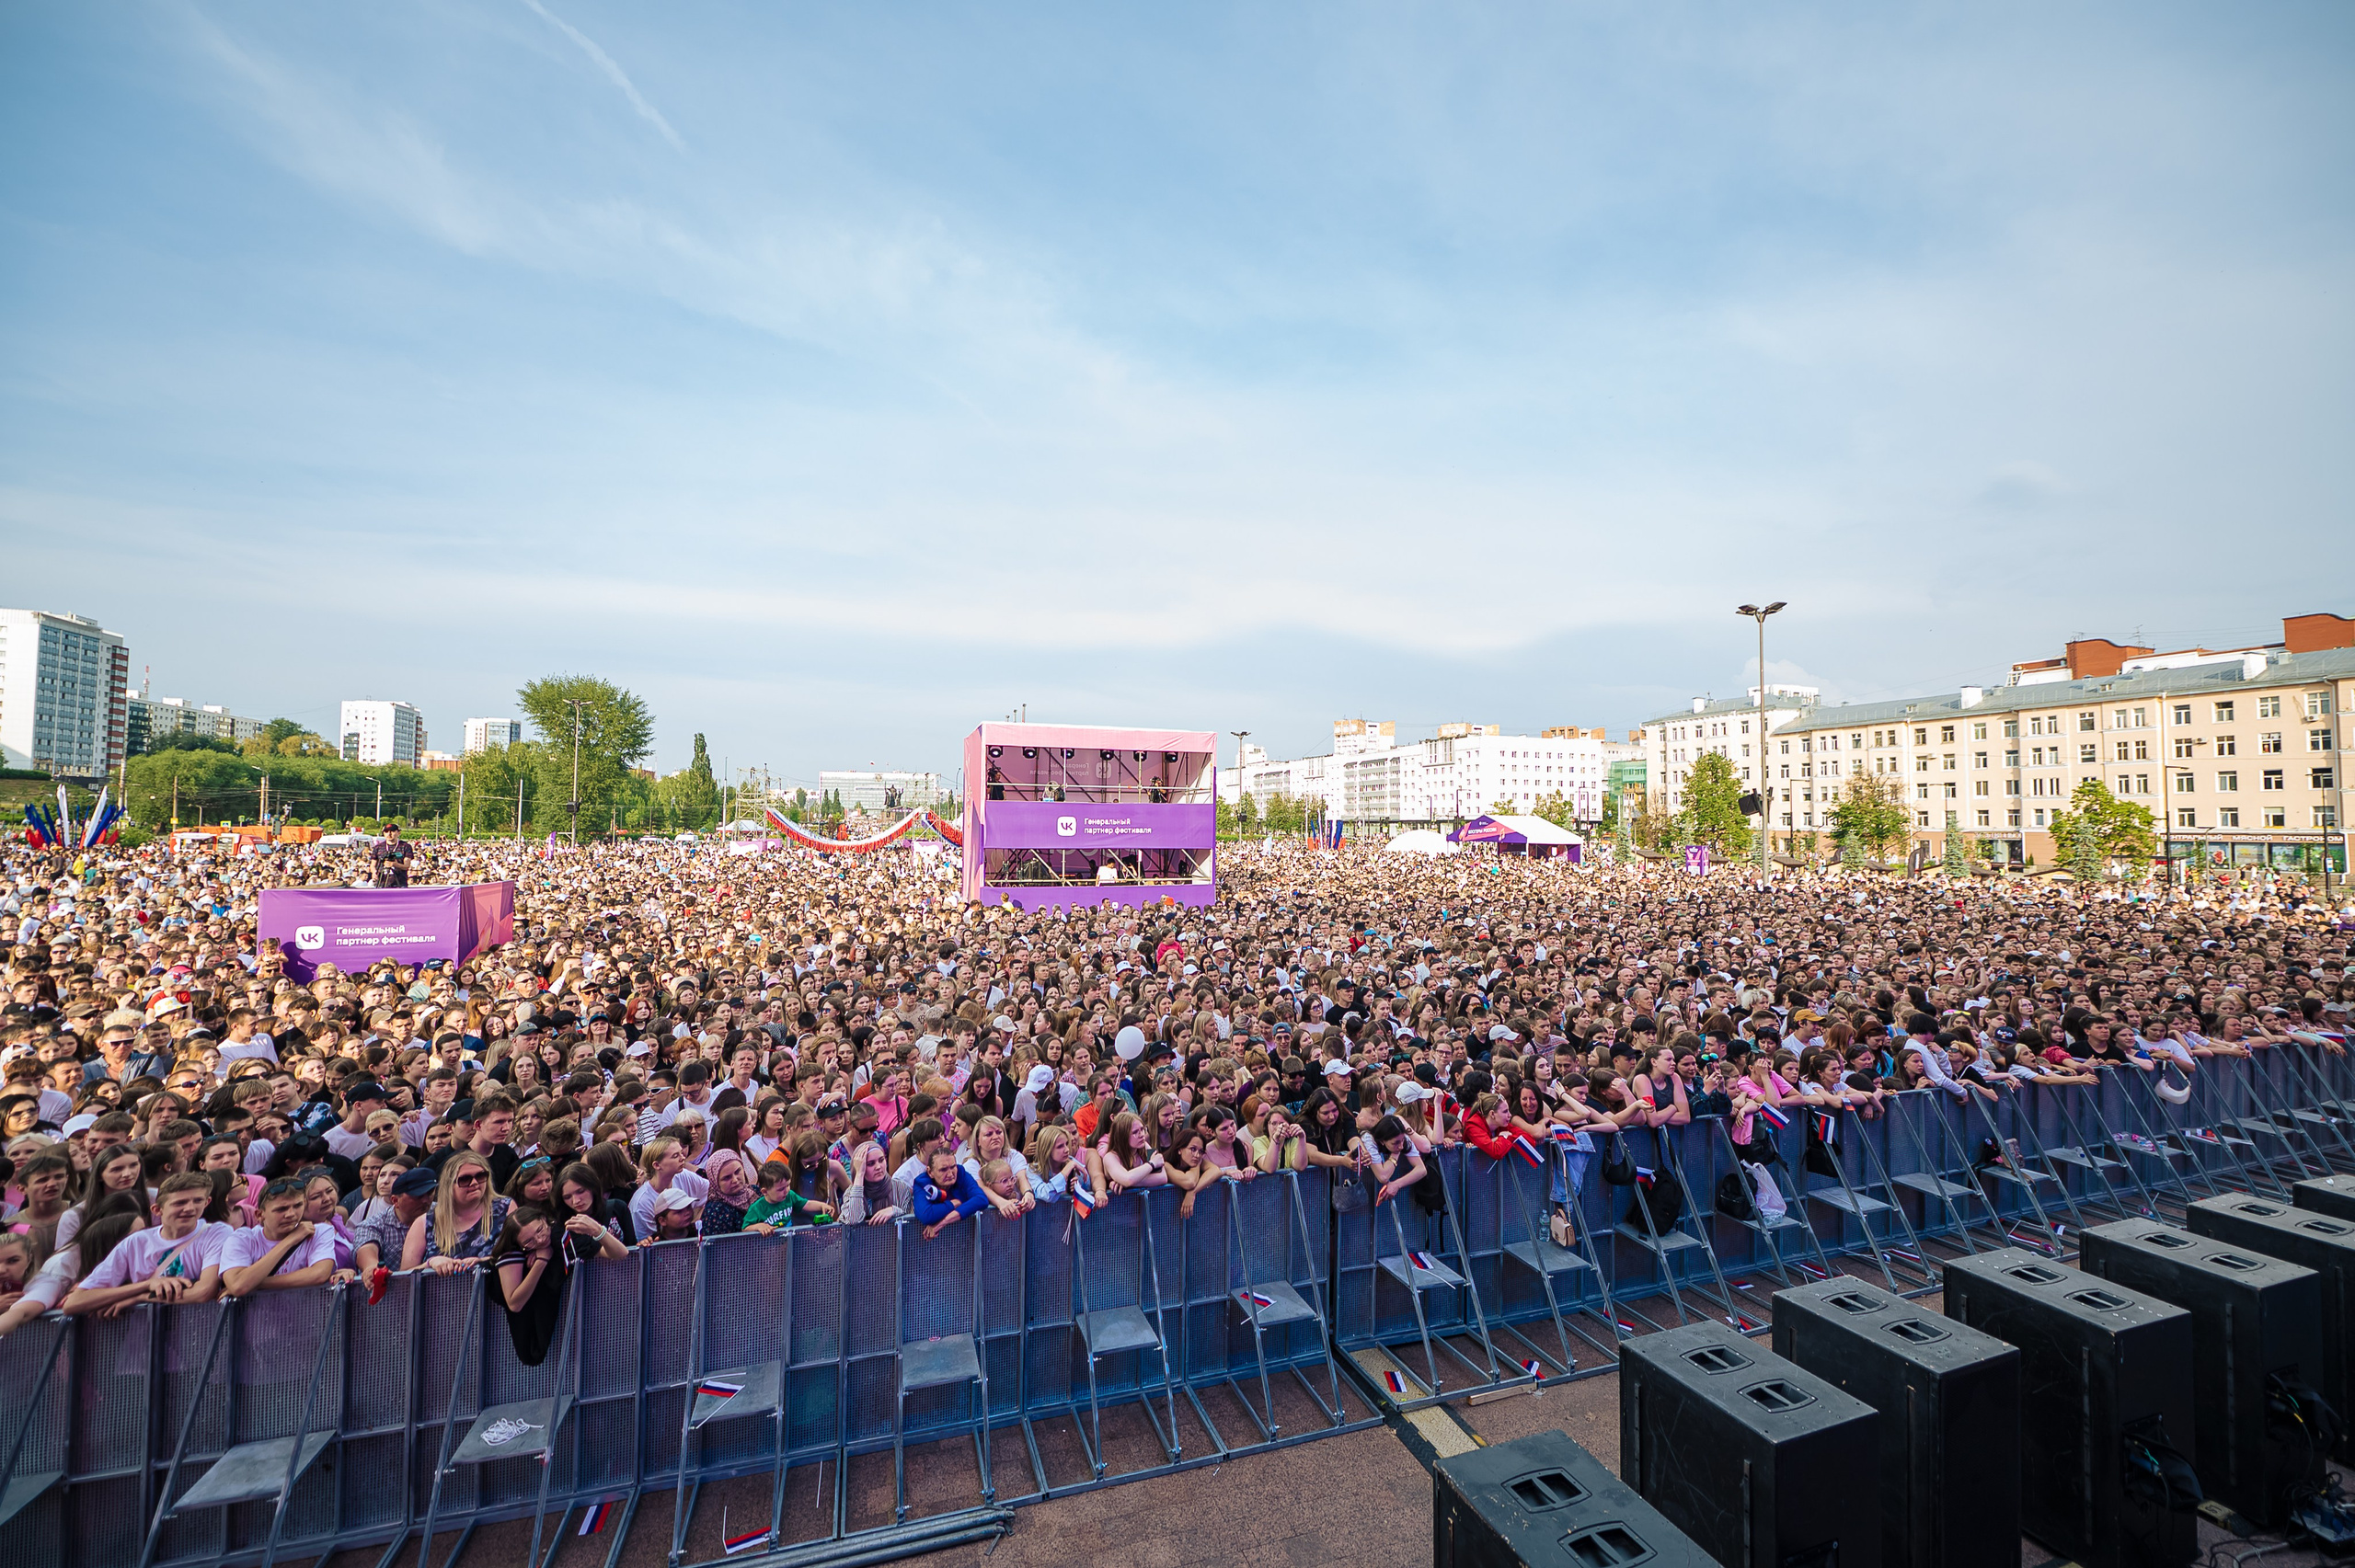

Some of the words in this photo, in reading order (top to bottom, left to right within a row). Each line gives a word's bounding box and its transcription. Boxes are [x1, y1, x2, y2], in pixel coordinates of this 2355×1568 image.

[1061, 822, 1073, 830] VK
[1114, 827, 1152, 835] фестиваля
[336, 924, 406, 936] Генеральный
[301, 933, 318, 943] VK
[336, 937, 380, 946] партнер
[381, 935, 436, 945] фестиваля
